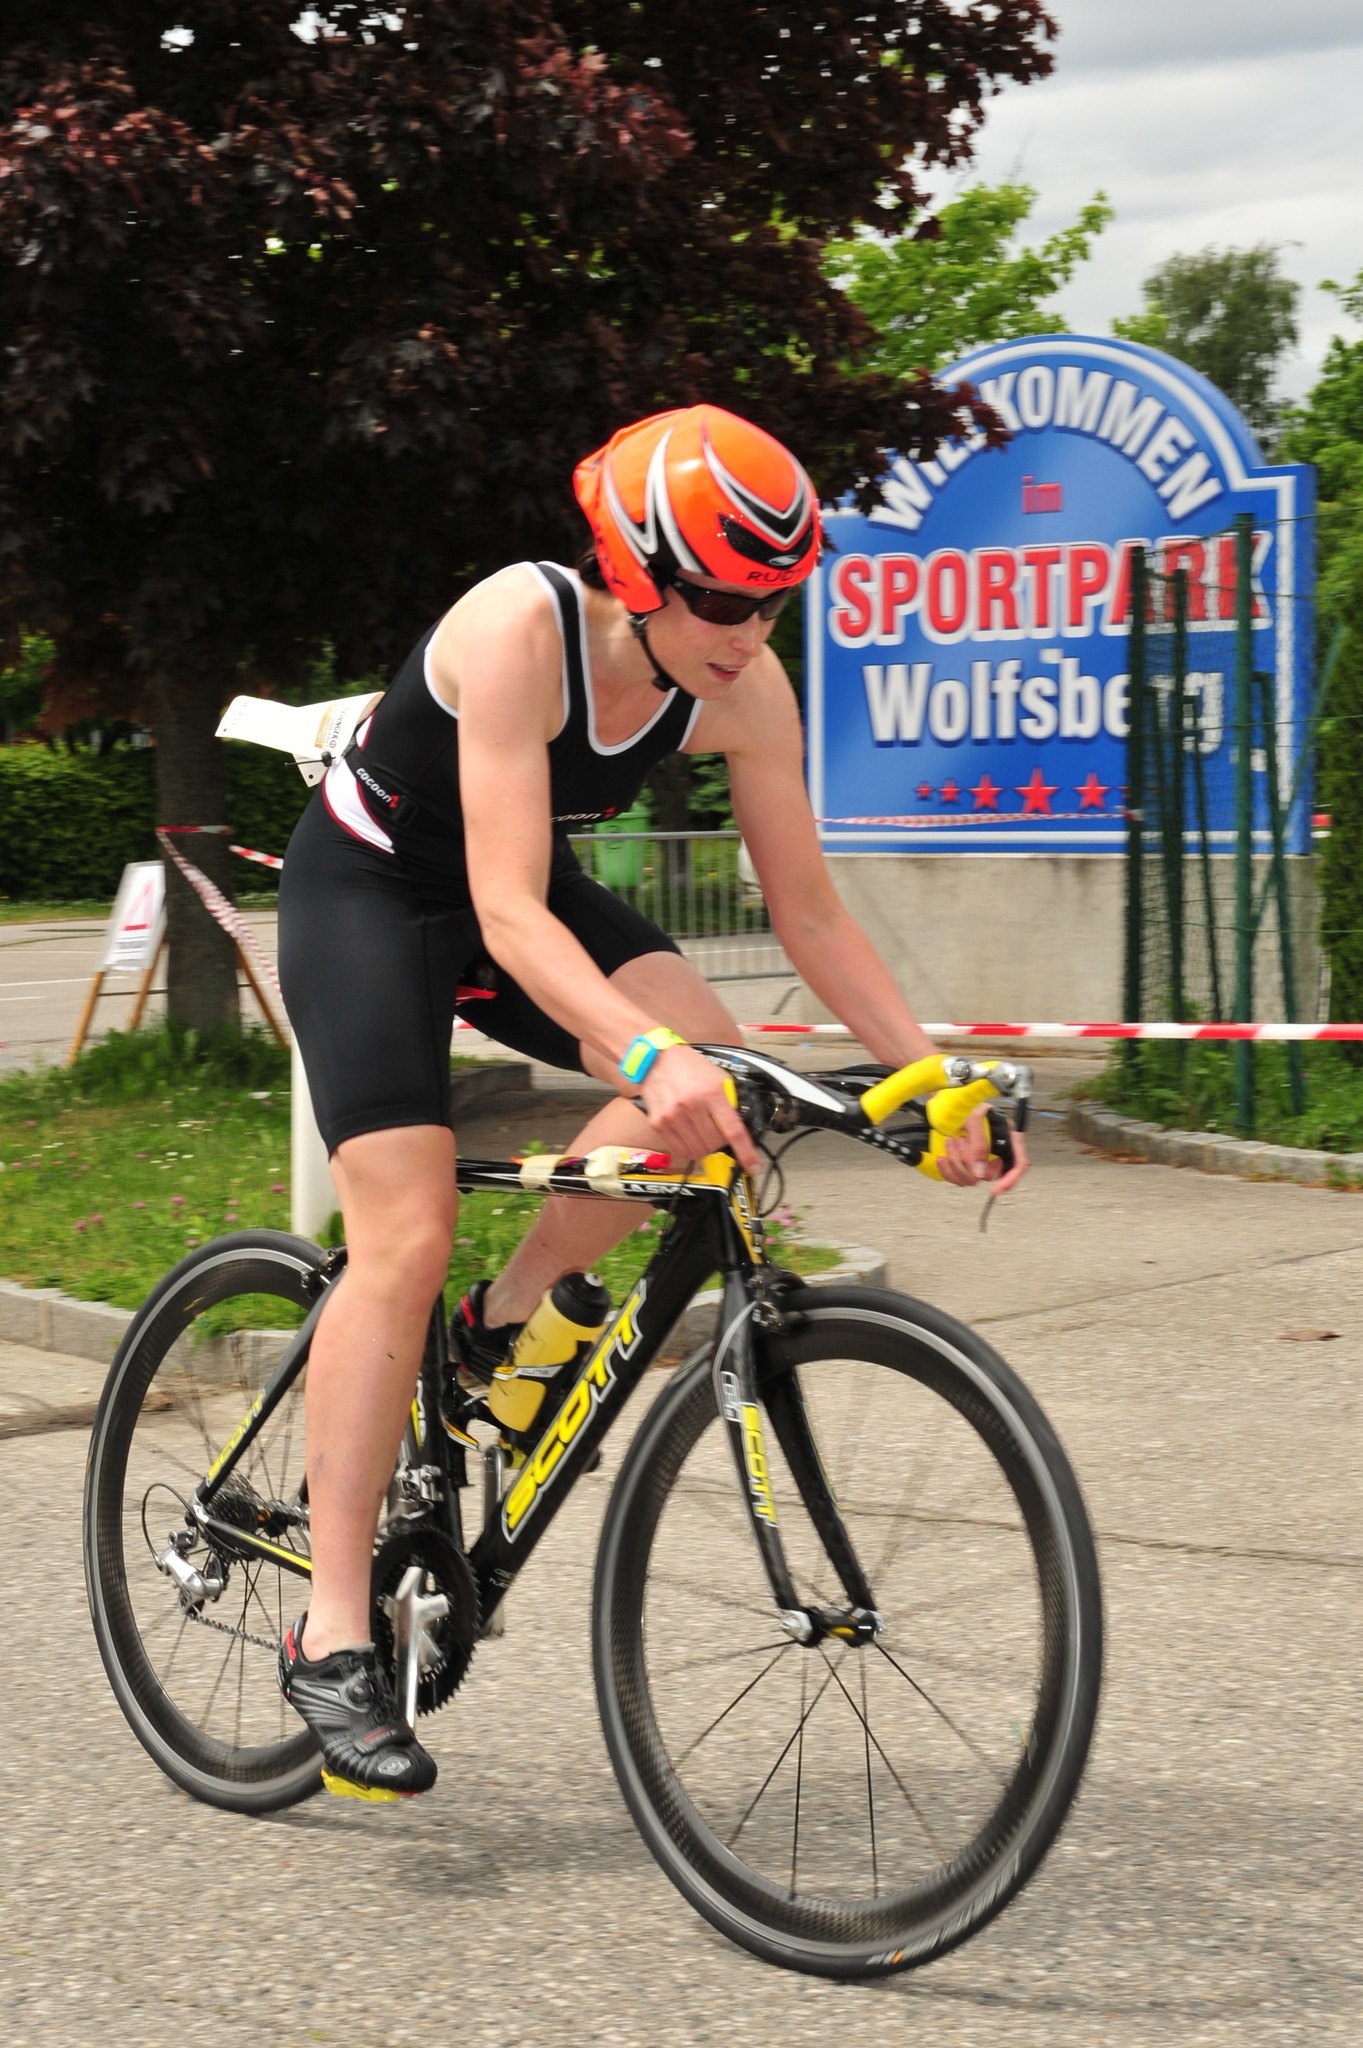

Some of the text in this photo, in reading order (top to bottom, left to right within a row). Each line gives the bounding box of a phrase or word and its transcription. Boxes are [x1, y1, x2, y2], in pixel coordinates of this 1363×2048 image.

[830, 532, 1273, 648] SPORTPARK
[863, 656, 1224, 754] Wolfsberg
[356, 767, 392, 803] cocoon
[550, 812, 602, 822] coon
[623, 1182, 696, 1196] LASMA
[502, 1279, 647, 1543] SCOTT
